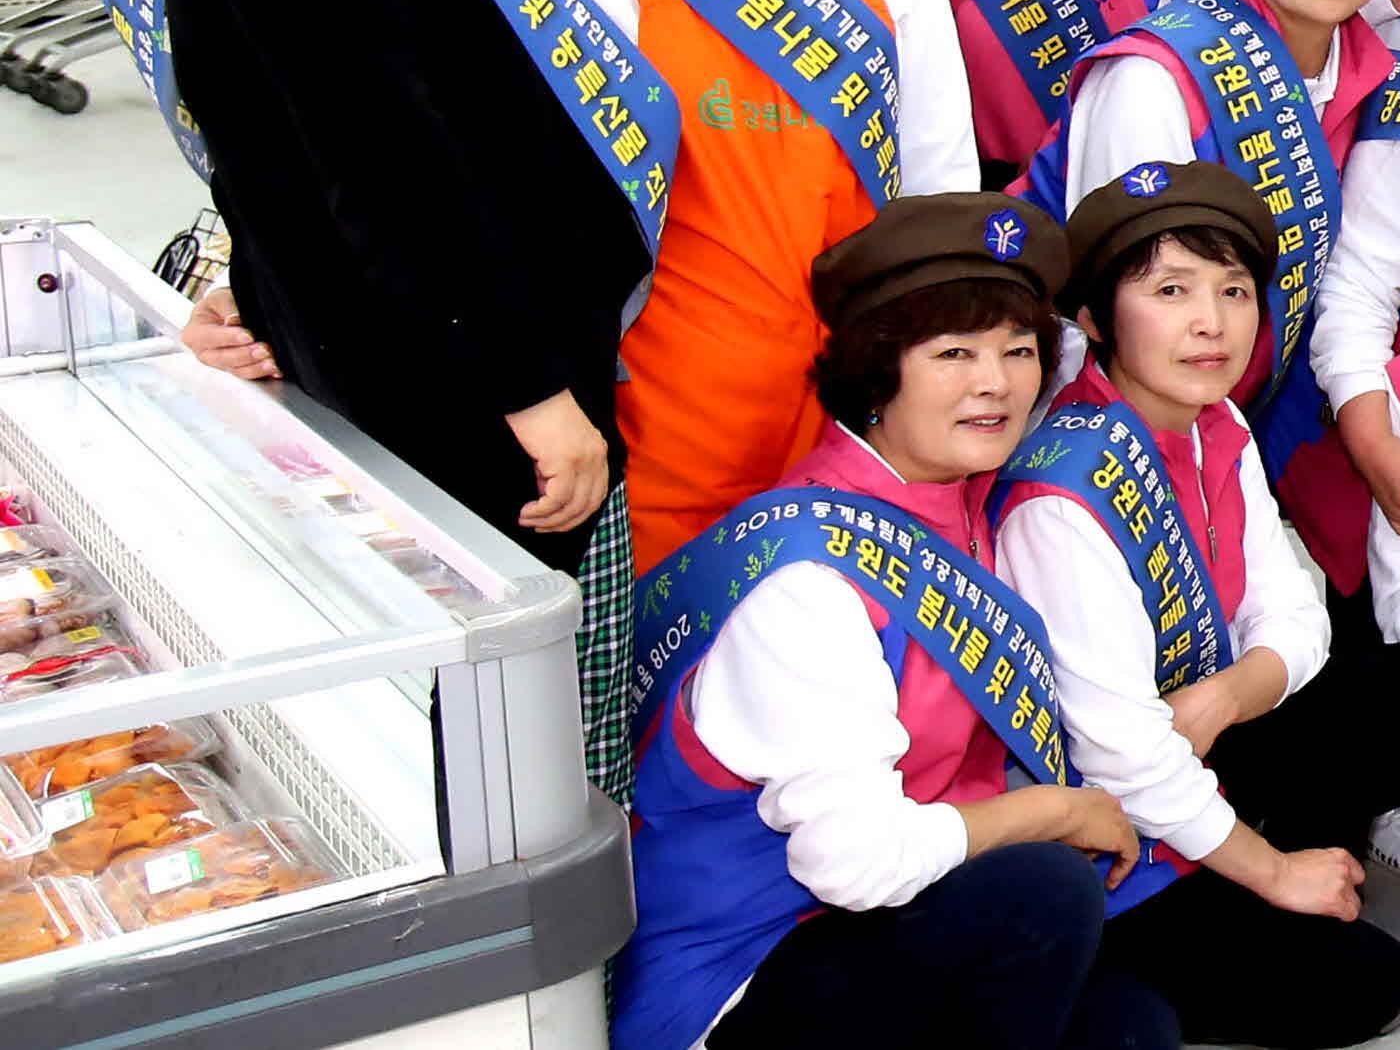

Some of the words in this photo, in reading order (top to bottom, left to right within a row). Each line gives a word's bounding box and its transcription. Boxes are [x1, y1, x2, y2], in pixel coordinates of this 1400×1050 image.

[550, 27, 649, 168] 농특산물
[830, 72, 870, 117] 및
[1030, 34, 1067, 70] 및
[739, 99, 824, 131] 강원나
[1199, 36, 1264, 124] 강원도
[1238, 129, 1297, 218] 봄나물
[1277, 224, 1305, 256] 및
[1228, 18, 1290, 103] 동계올림픽
[1275, 105, 1329, 222] 성공개최기념
[1092, 450, 1155, 545] 강원도
[1109, 420, 1166, 508] 동계올림픽
[1162, 510, 1208, 612] 성공개최기념
[733, 502, 800, 543] 2018
[811, 500, 914, 556] 동계올림픽
[919, 546, 1010, 635] 성공개최기념
[818, 524, 912, 599] 강원도
[917, 583, 991, 674] 봄나물
[985, 659, 1015, 704] 및
[1146, 541, 1188, 634] 봄나물
[1163, 631, 1192, 665] 및
